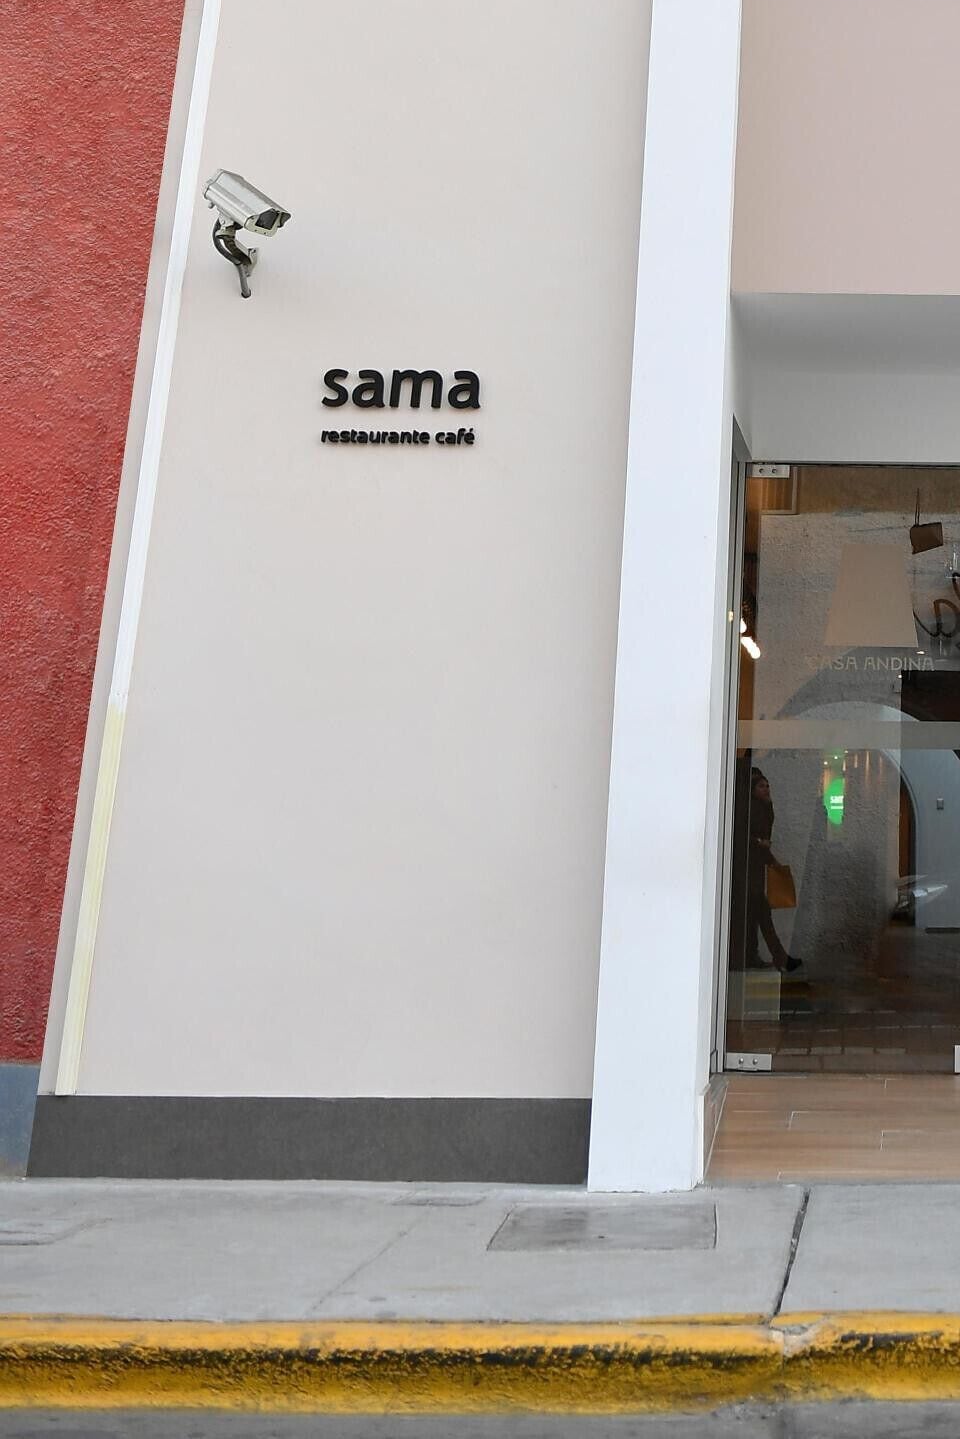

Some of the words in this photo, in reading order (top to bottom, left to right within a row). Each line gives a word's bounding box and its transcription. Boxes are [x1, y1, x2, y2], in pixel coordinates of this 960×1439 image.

[321, 368, 481, 410] sama
[321, 428, 431, 445] restaurante
[434, 427, 475, 446] café
[863, 655, 936, 671] ANDINA
